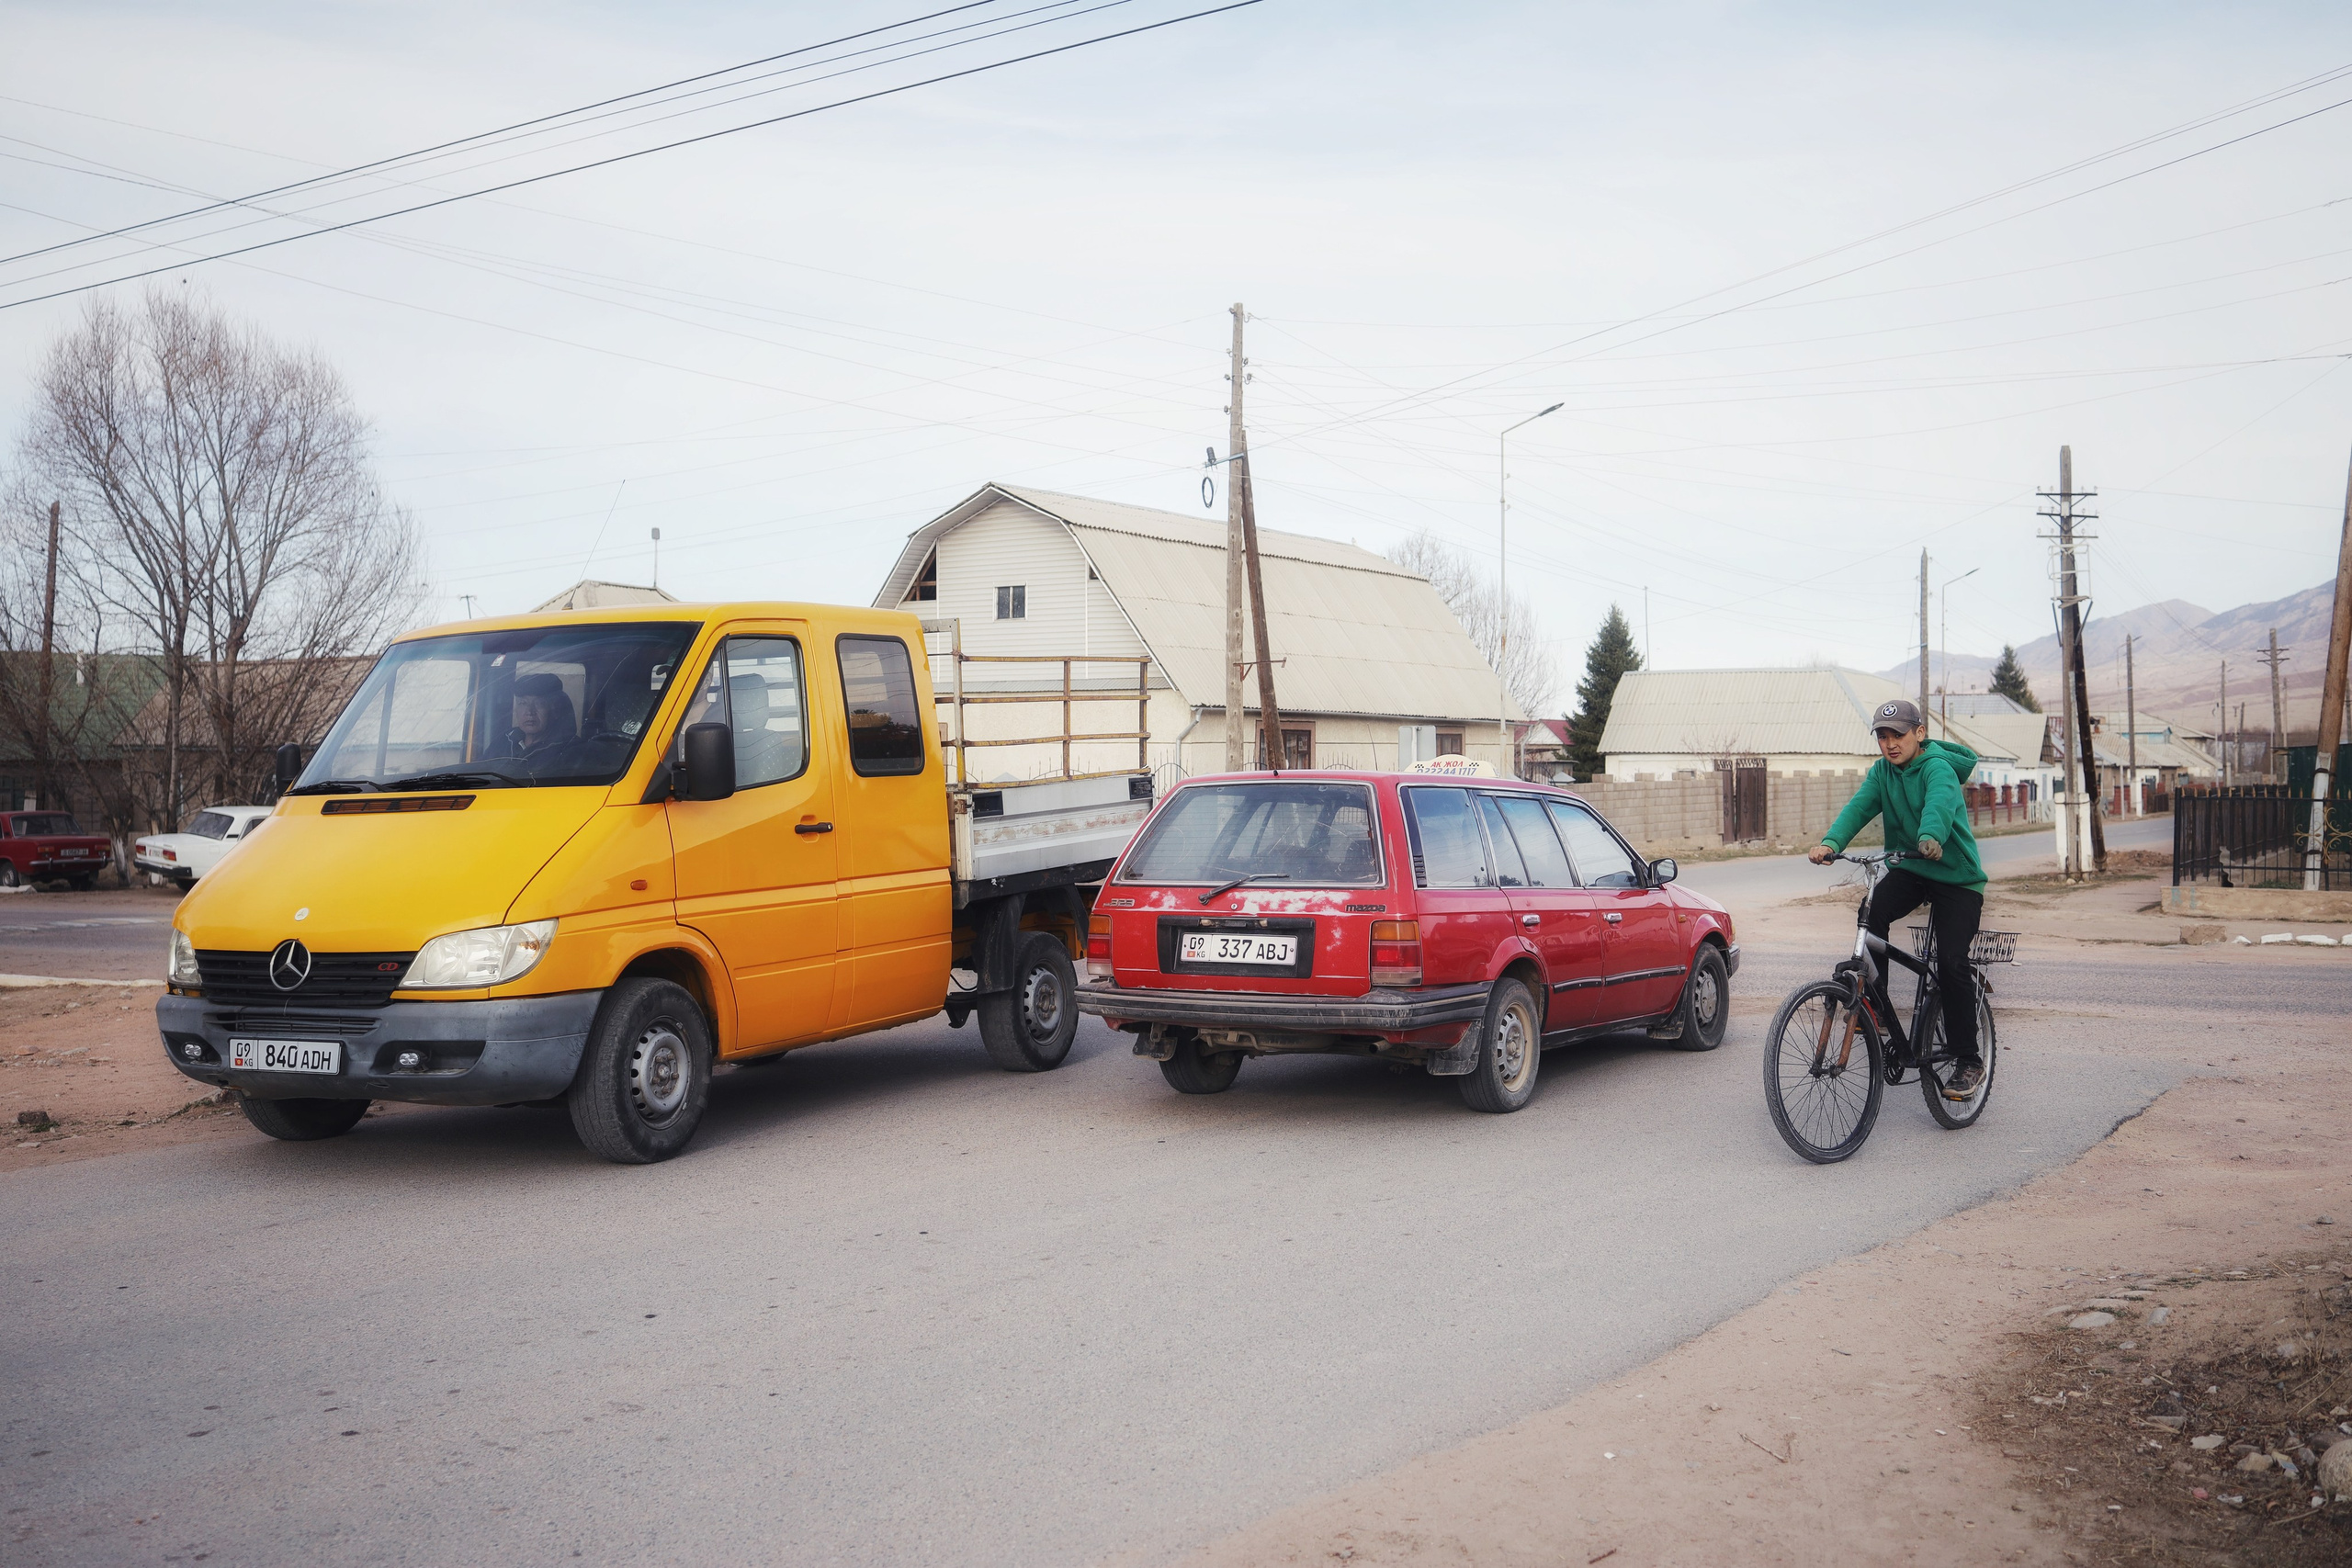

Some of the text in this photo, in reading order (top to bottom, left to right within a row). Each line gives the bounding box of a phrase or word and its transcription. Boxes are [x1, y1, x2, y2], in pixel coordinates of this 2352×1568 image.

[1189, 937, 1288, 961] 09 337 ABJ
[236, 1043, 332, 1070] 09 840 ADH
[243, 1058, 254, 1066] KG
